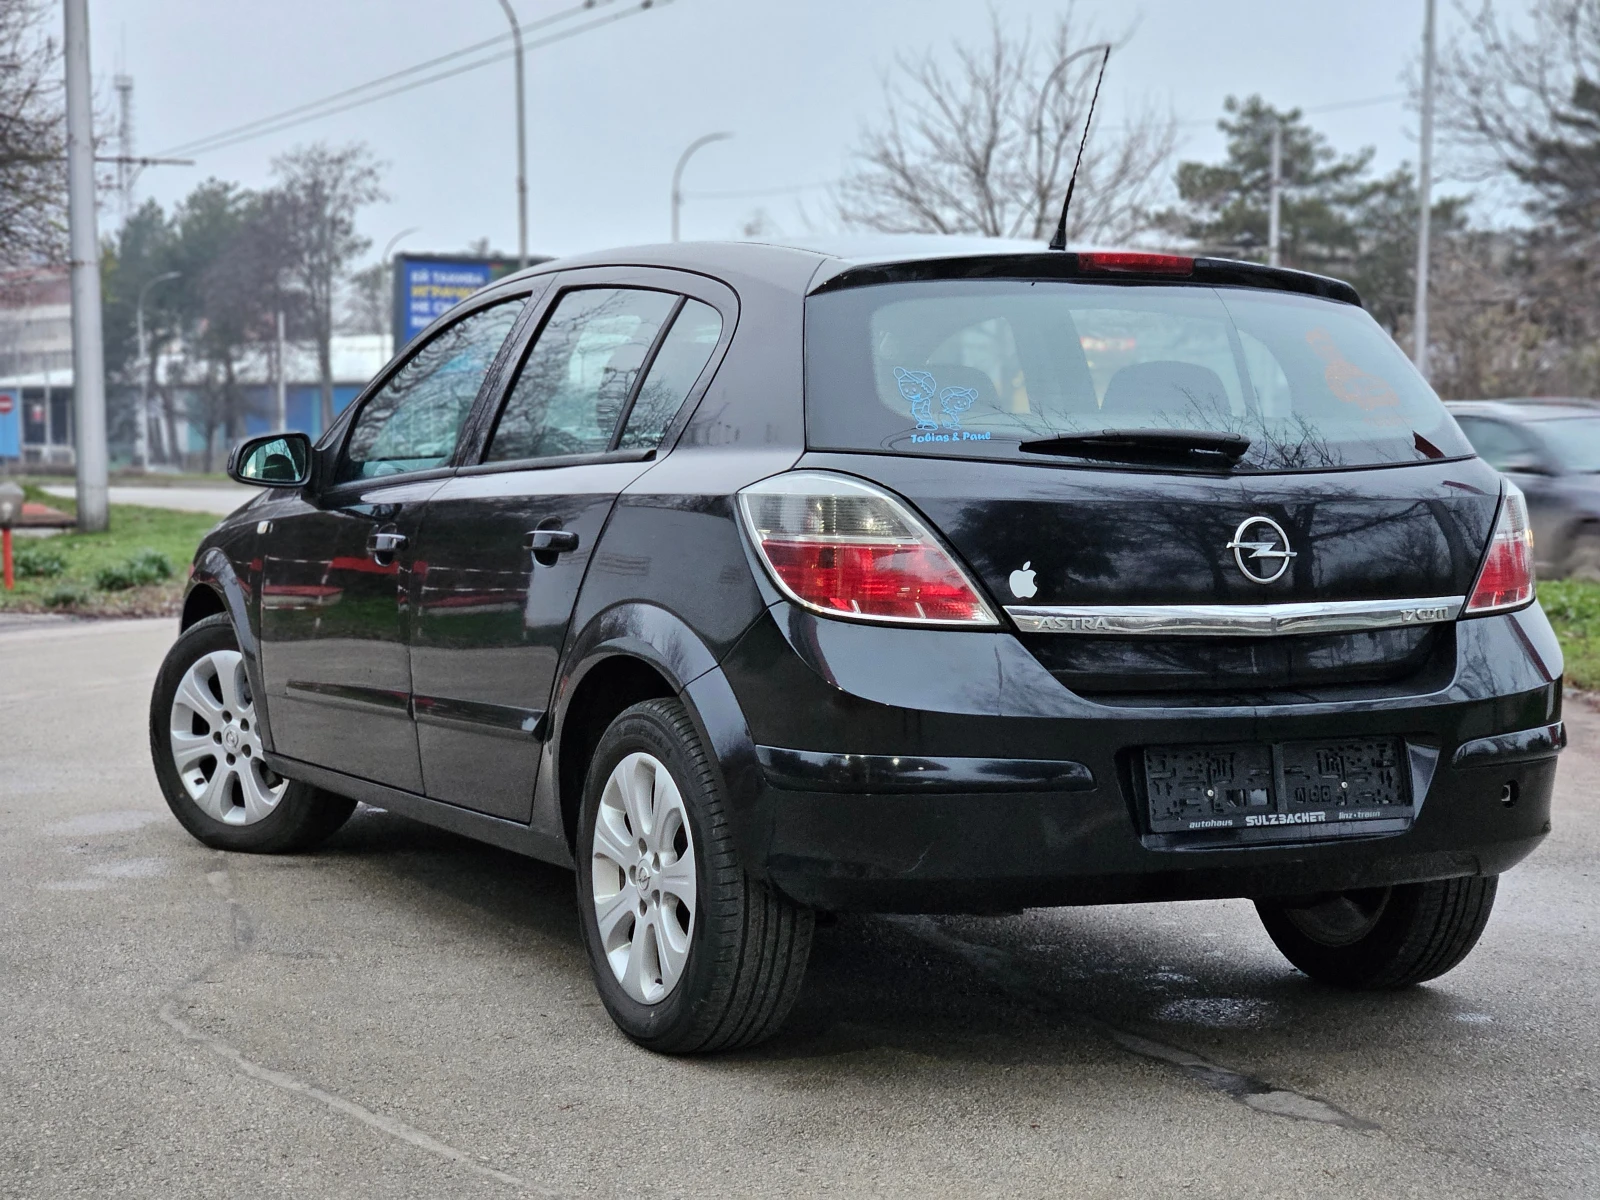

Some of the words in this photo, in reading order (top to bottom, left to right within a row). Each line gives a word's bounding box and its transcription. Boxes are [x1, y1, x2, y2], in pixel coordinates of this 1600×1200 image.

[911, 433, 950, 443] Tobias
[952, 432, 960, 442] &
[962, 431, 991, 441] Paul
[1037, 616, 1110, 630] ASTRA
[1189, 819, 1233, 829] autohaus
[1245, 811, 1326, 827] SULZBACHER
